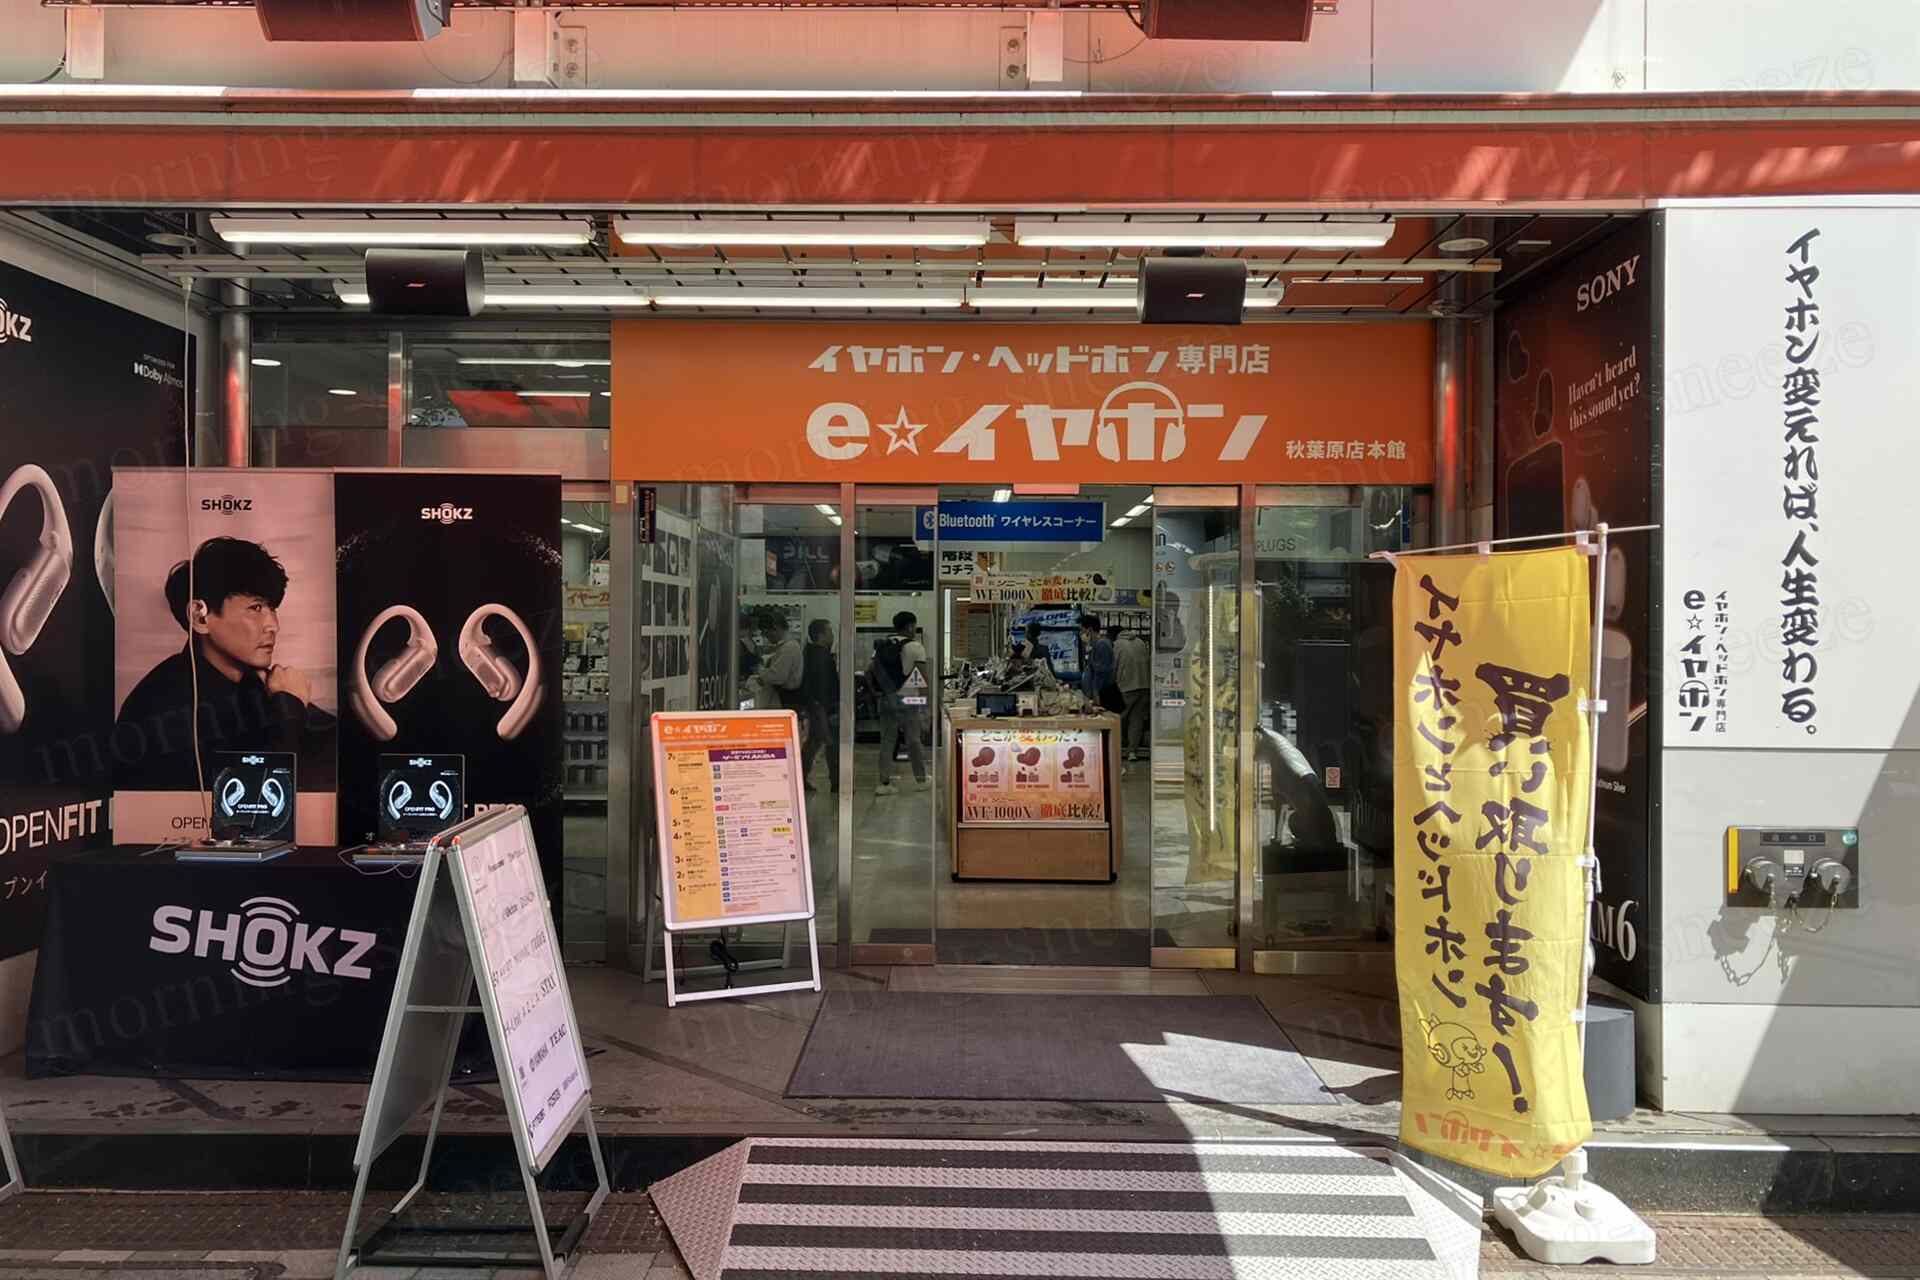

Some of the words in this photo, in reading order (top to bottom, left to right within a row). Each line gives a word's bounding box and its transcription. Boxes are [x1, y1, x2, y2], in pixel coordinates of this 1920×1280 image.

[1576, 255, 1641, 312] SONY
[808, 344, 1270, 375] イヤホン・ヘッドホン専門店
[142, 364, 164, 385] Dolby
[1568, 372, 1602, 405] Haven't
[1605, 345, 1638, 382] heard
[1569, 406, 1588, 432] this
[1588, 385, 1618, 422] sound
[1617, 372, 1642, 411] yet?
[1286, 439, 1407, 460] 秋葉原店本館
[201, 495, 253, 514] SHOKZ
[420, 504, 474, 523] SHOKZ
[939, 513, 995, 528] Bluetooth
[1000, 516, 1097, 528] ワイヤレスコーナー
[941, 563, 975, 575] コチラ
[149, 899, 377, 985] SHOKZ
